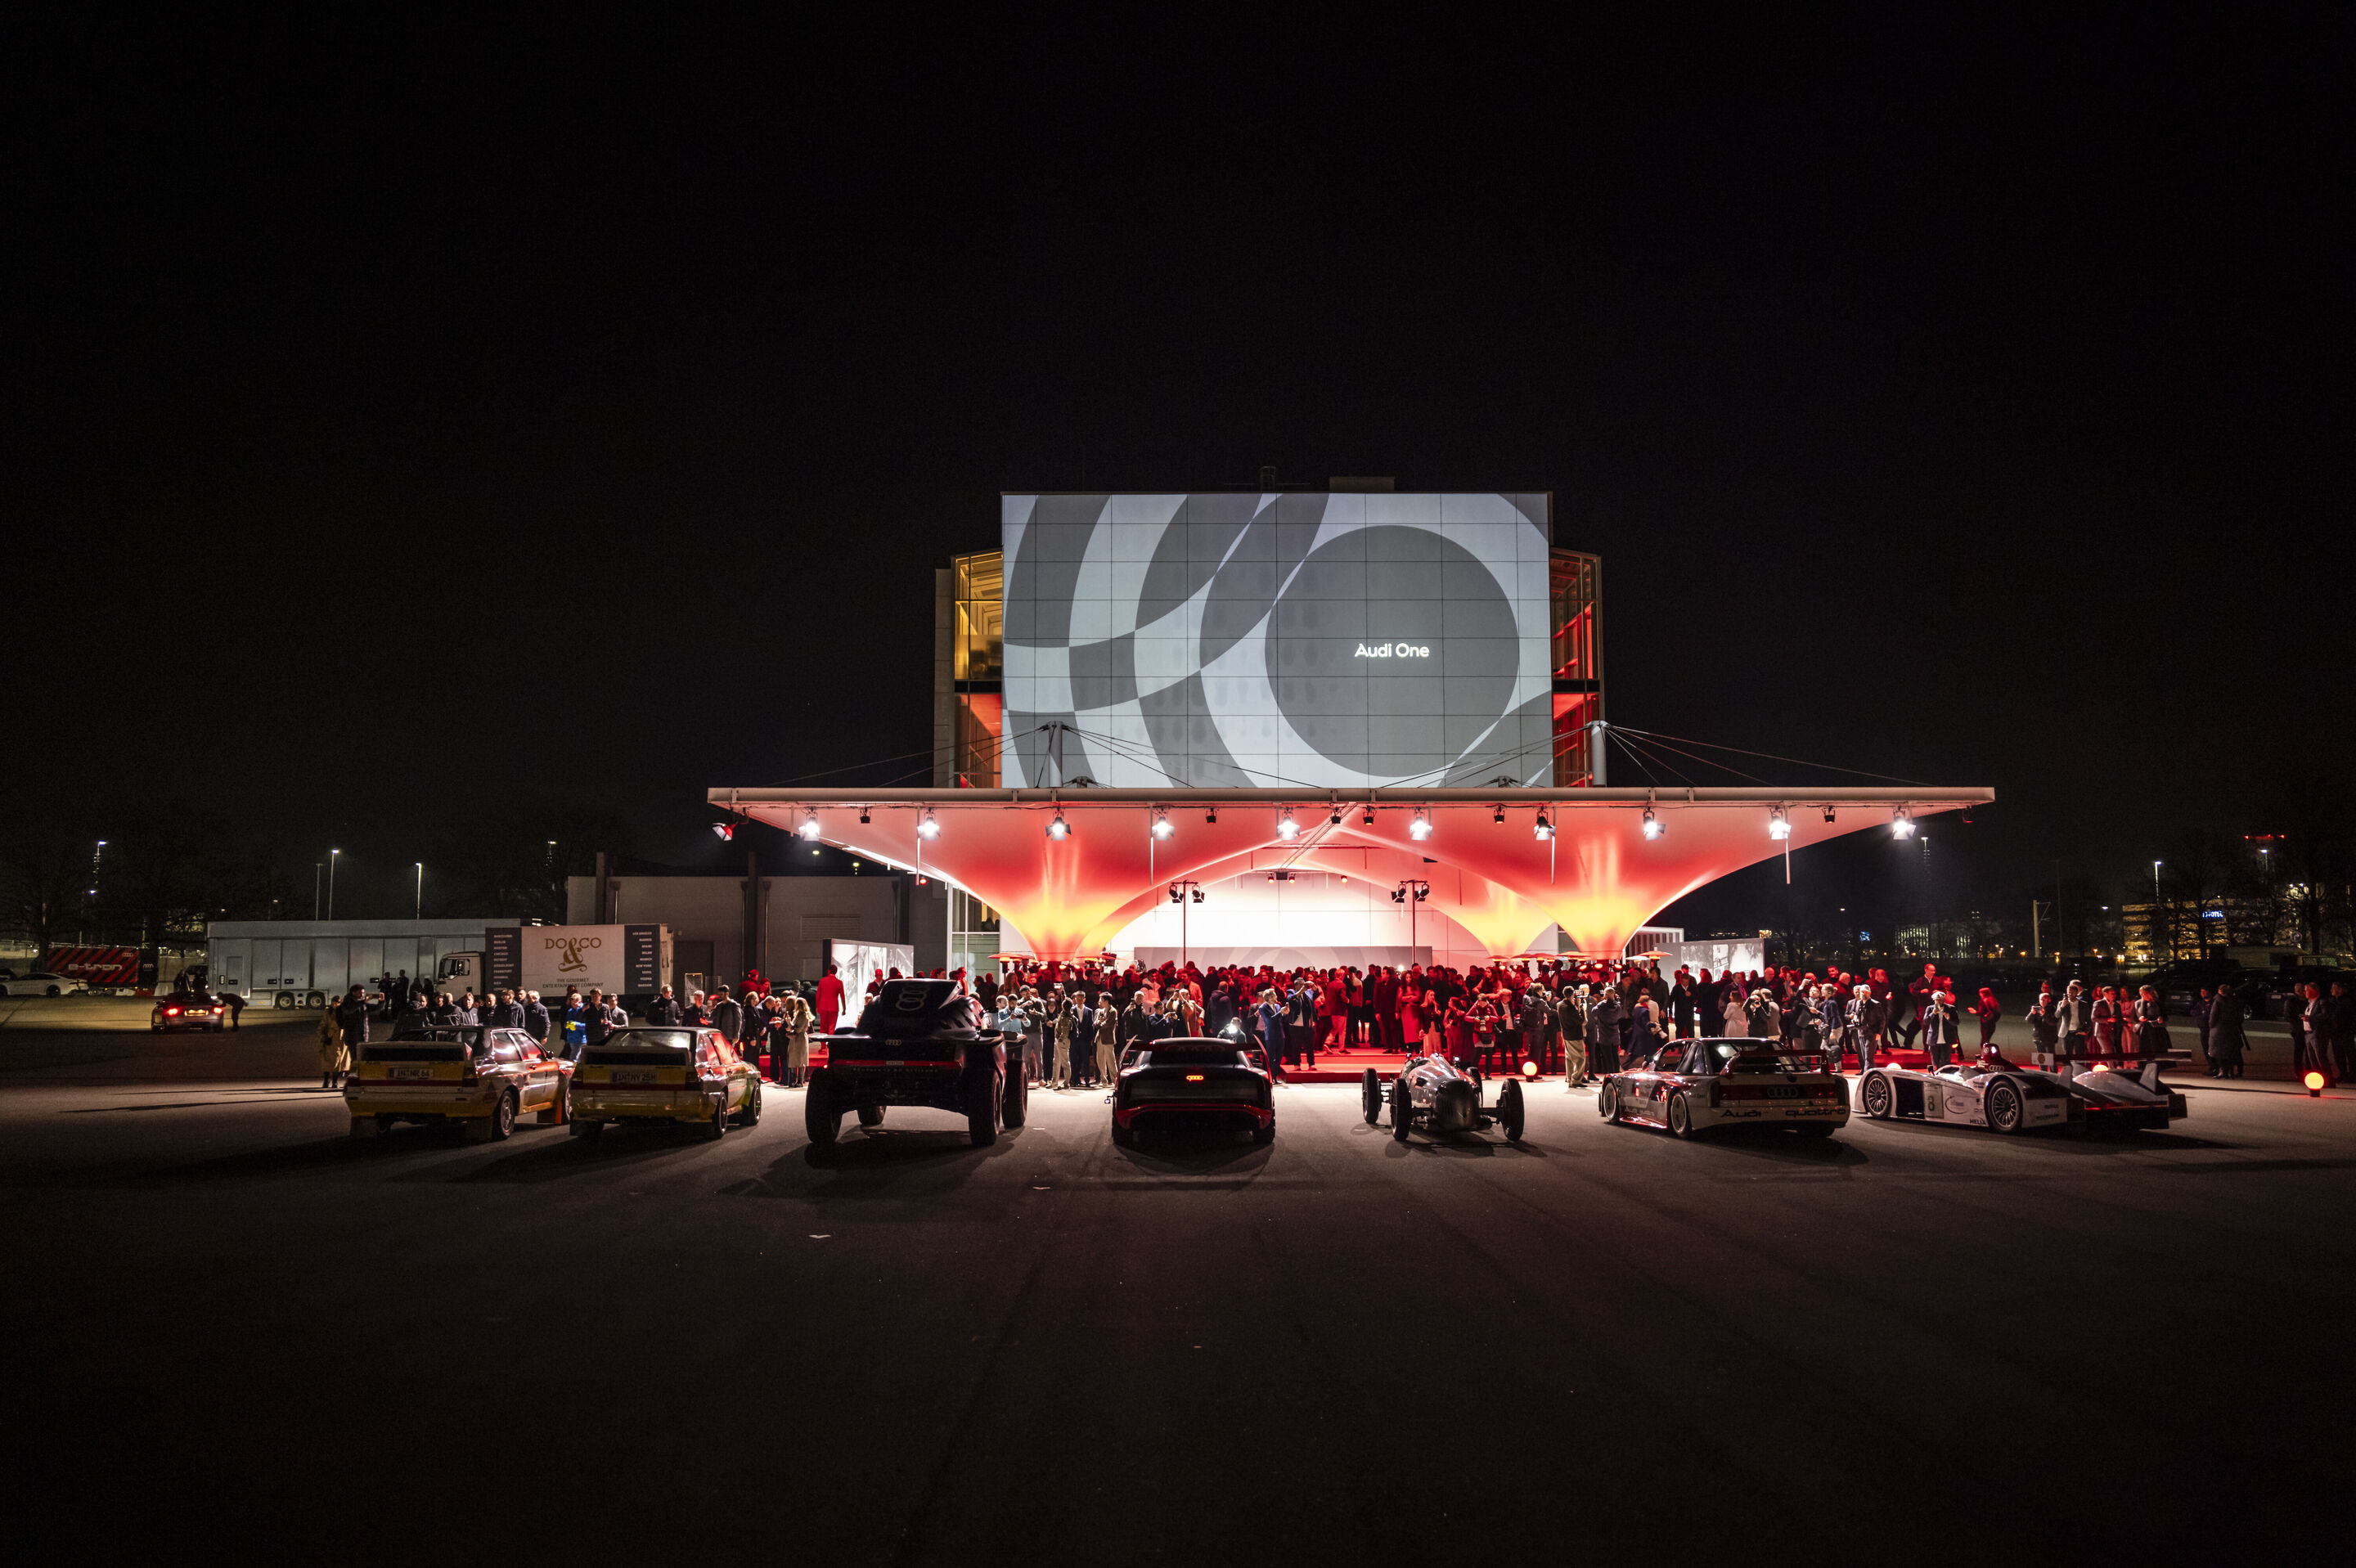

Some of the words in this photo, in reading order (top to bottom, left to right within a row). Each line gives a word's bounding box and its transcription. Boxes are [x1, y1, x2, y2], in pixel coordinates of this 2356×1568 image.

[1355, 643, 1392, 657] Audi
[1396, 642, 1430, 658] One
[68, 963, 123, 971] e-tron
[1927, 1095, 1935, 1111] 8
[1721, 1109, 1761, 1117] Audi
[1785, 1108, 1846, 1117] quattro
